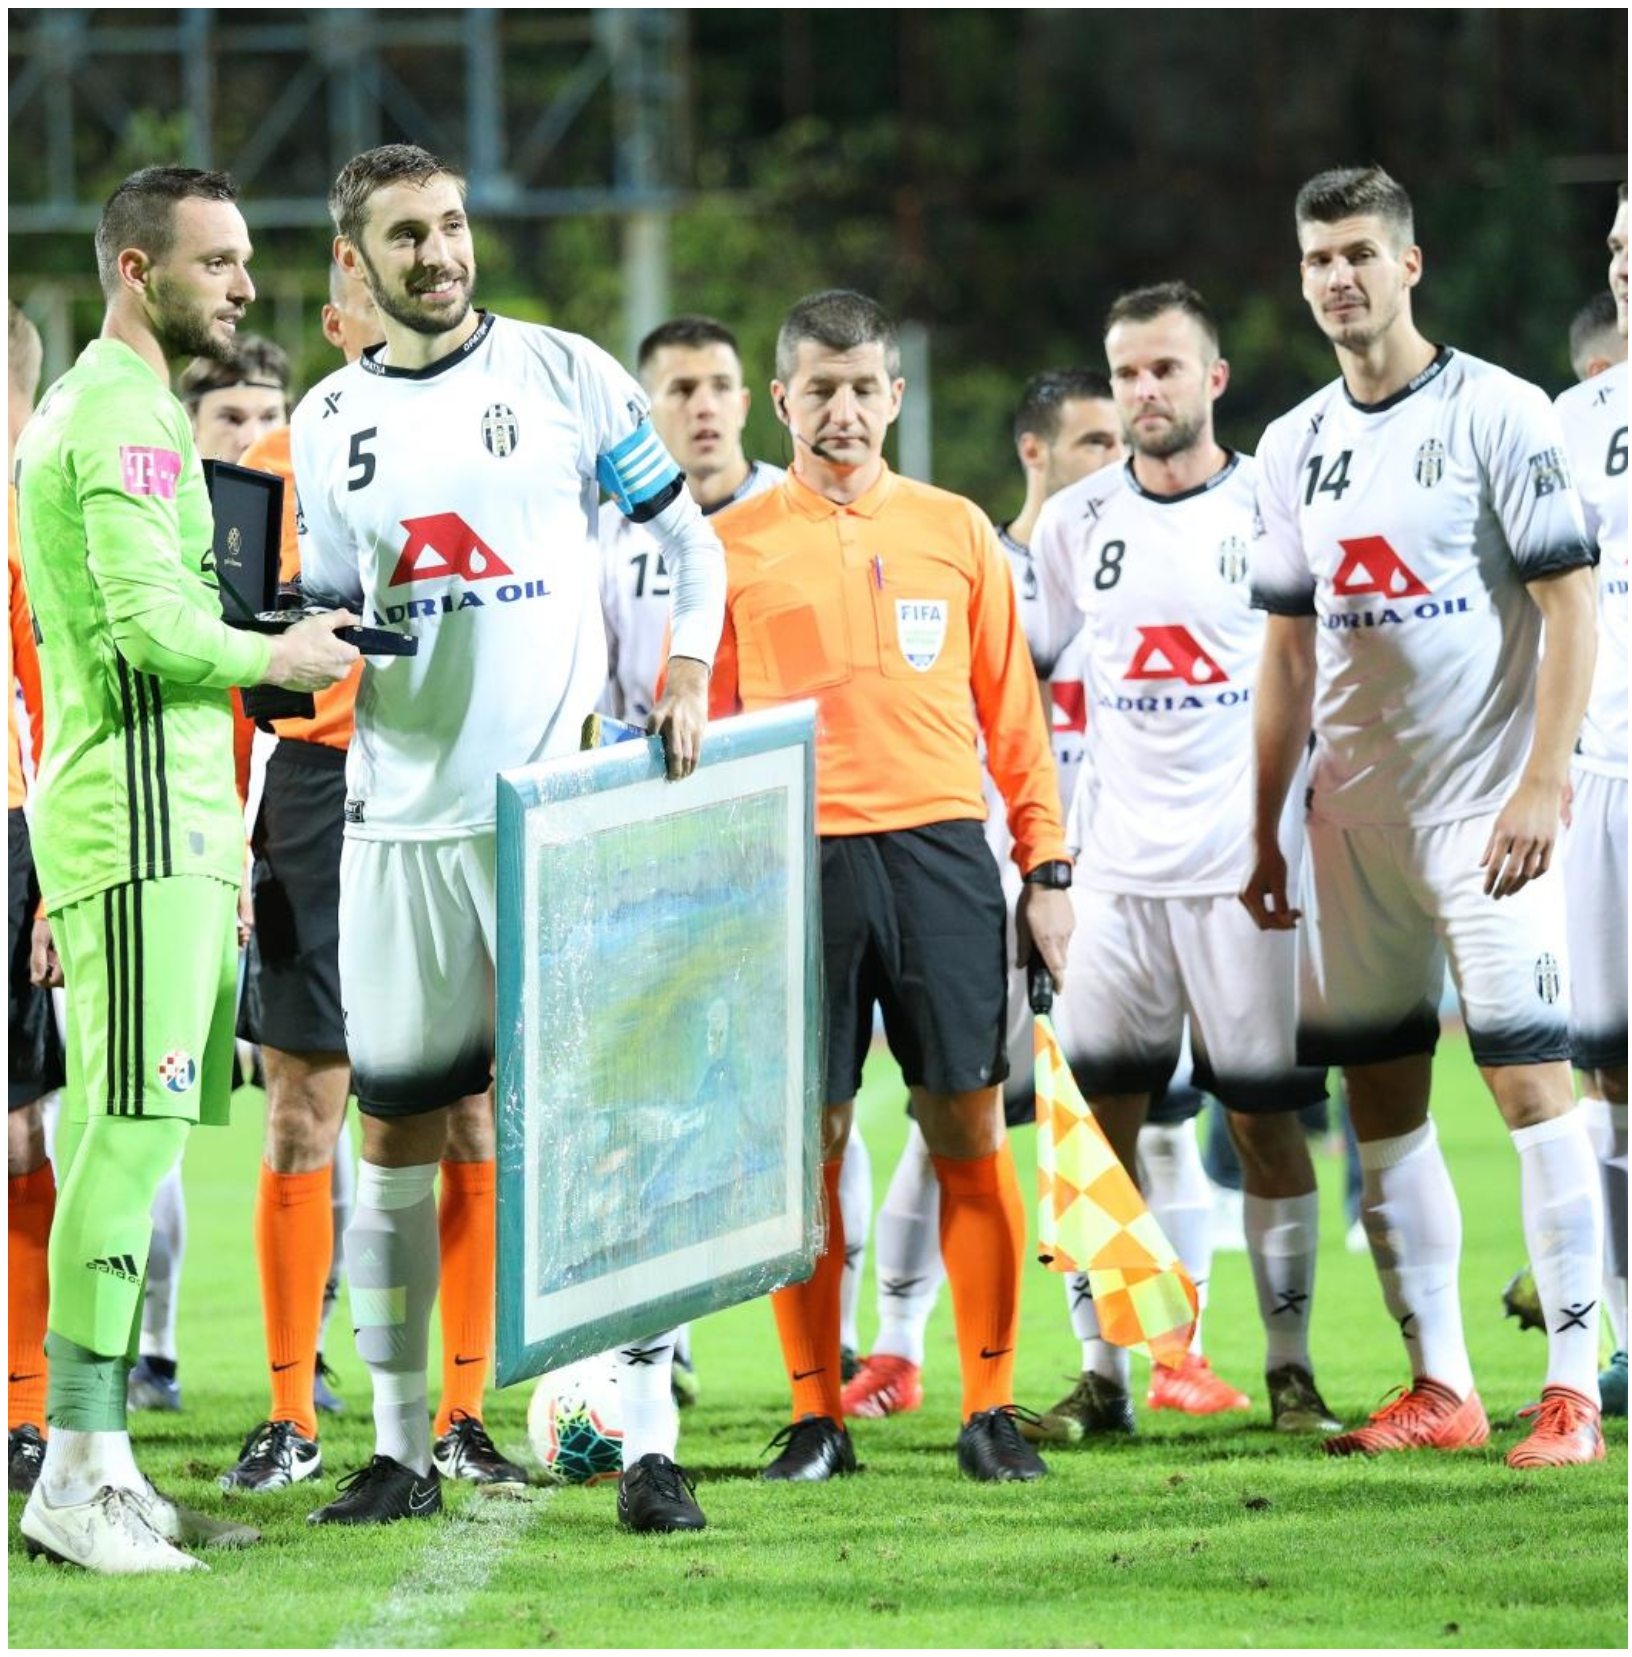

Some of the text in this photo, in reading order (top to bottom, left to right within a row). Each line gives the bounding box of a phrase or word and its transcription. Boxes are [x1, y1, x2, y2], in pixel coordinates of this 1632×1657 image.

[347, 426, 377, 492] 5
[1604, 426, 1629, 477] 6
[1304, 449, 1354, 506] 14
[1093, 539, 1126, 591] 8
[496, 580, 551, 603] OIL
[900, 605, 942, 621] FIFA
[1414, 597, 1473, 619] OIL
